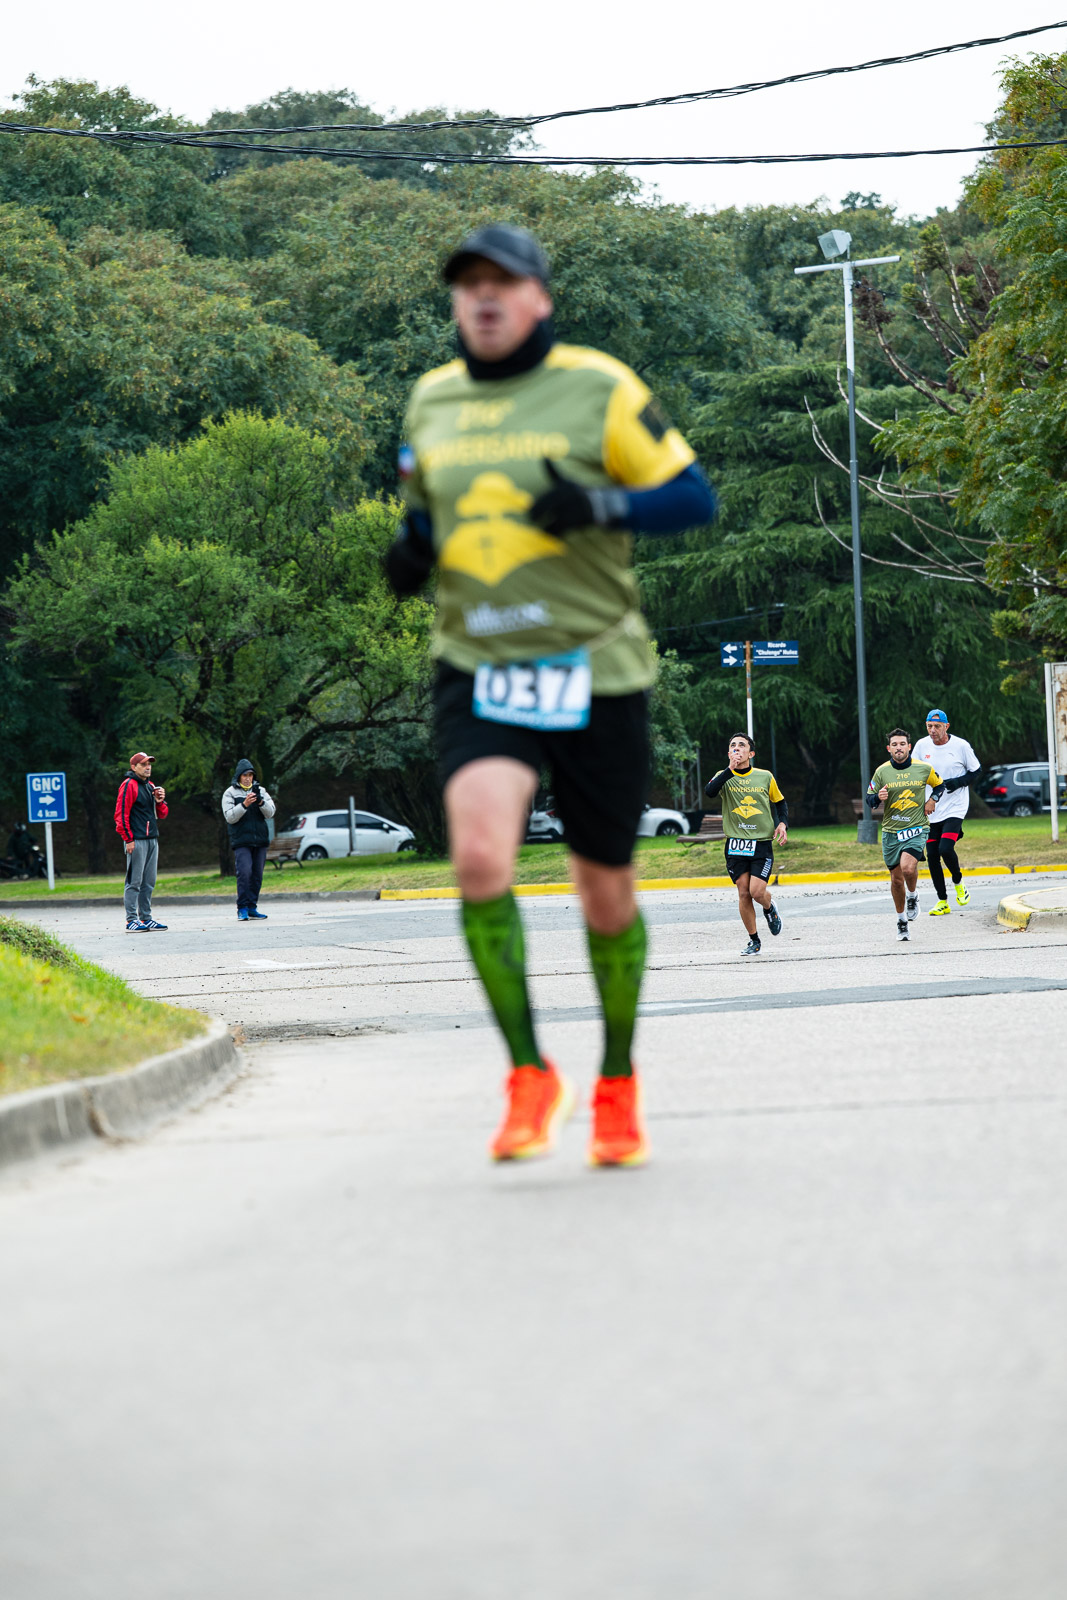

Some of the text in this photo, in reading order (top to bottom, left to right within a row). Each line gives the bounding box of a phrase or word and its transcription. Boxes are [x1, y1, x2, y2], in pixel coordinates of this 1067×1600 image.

[486, 665, 572, 711] 037
[32, 777, 61, 791] GNC
[37, 810, 58, 818] 4 km
[899, 829, 921, 840] 104
[730, 839, 754, 852] 004
